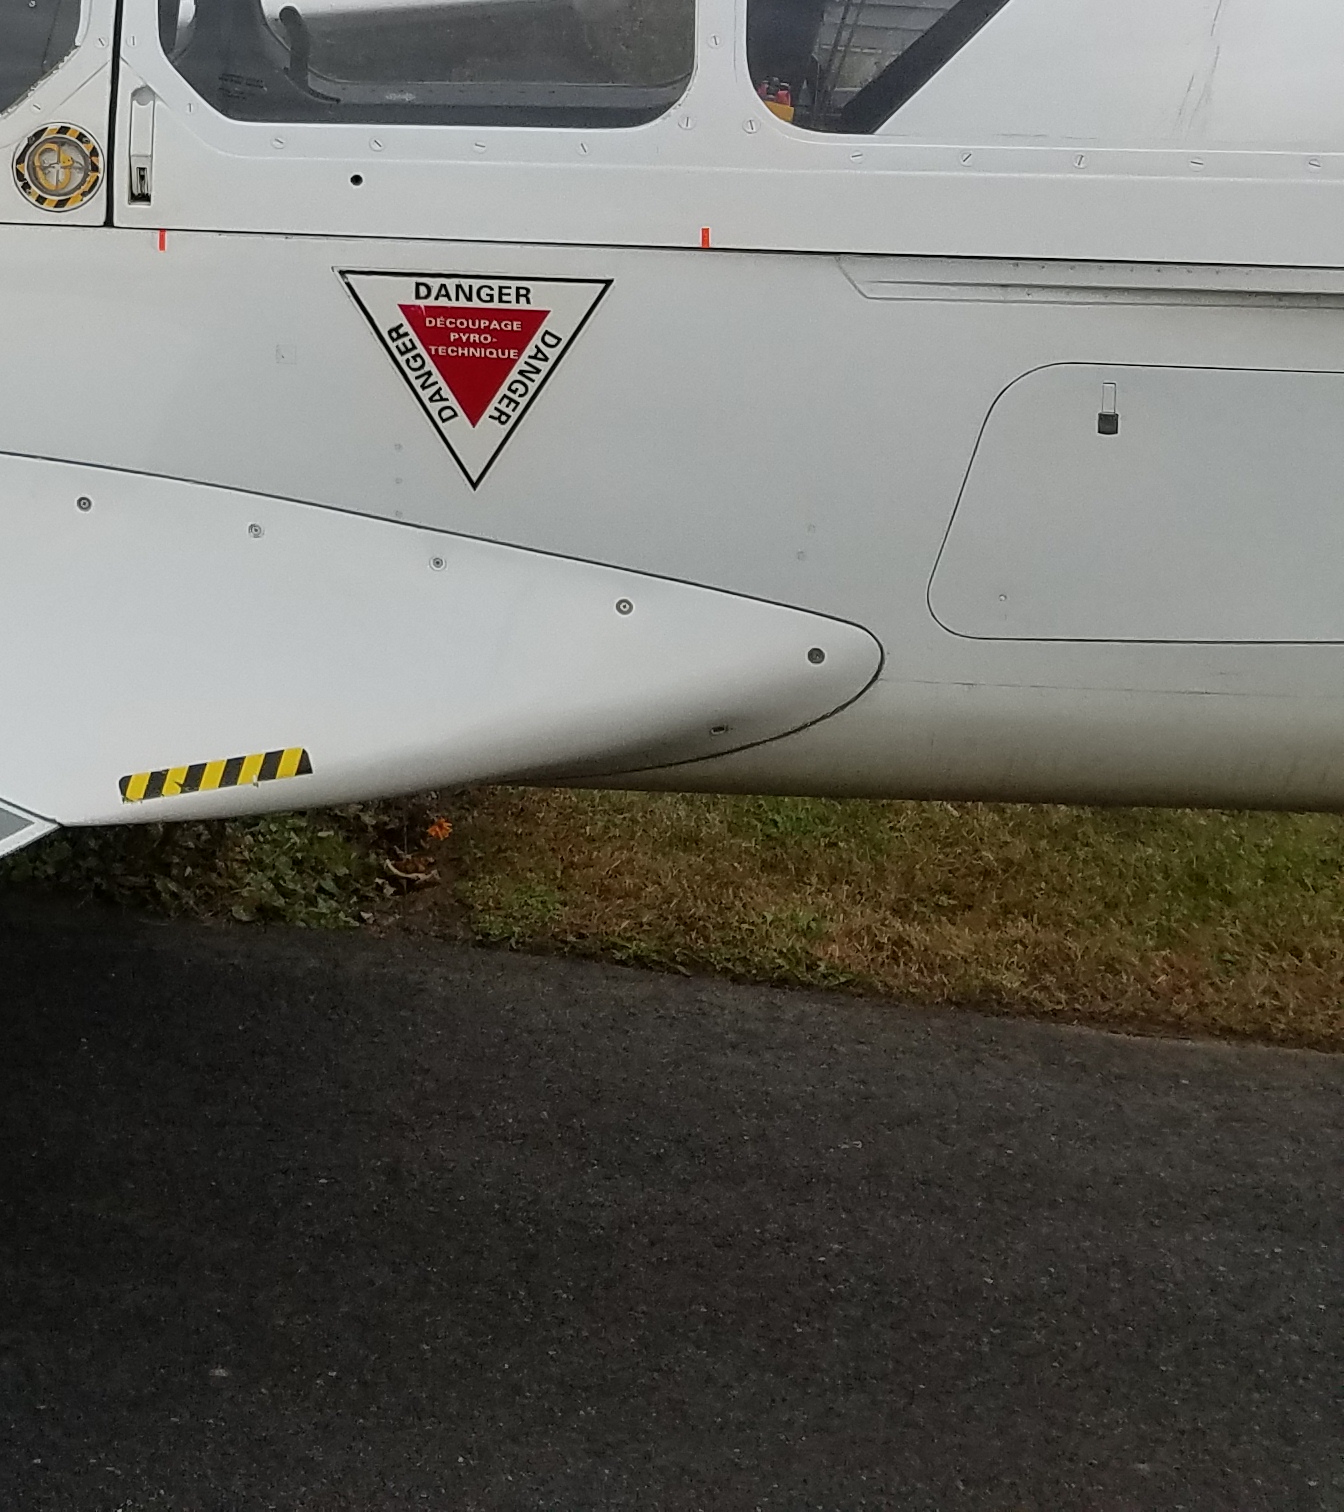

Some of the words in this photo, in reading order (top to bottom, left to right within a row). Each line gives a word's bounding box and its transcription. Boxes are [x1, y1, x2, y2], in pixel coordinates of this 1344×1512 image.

[413, 281, 532, 305] DANGER
[387, 322, 459, 424] DANGER
[428, 345, 520, 360] TECHNIQUE
[488, 329, 563, 427] DANGER
